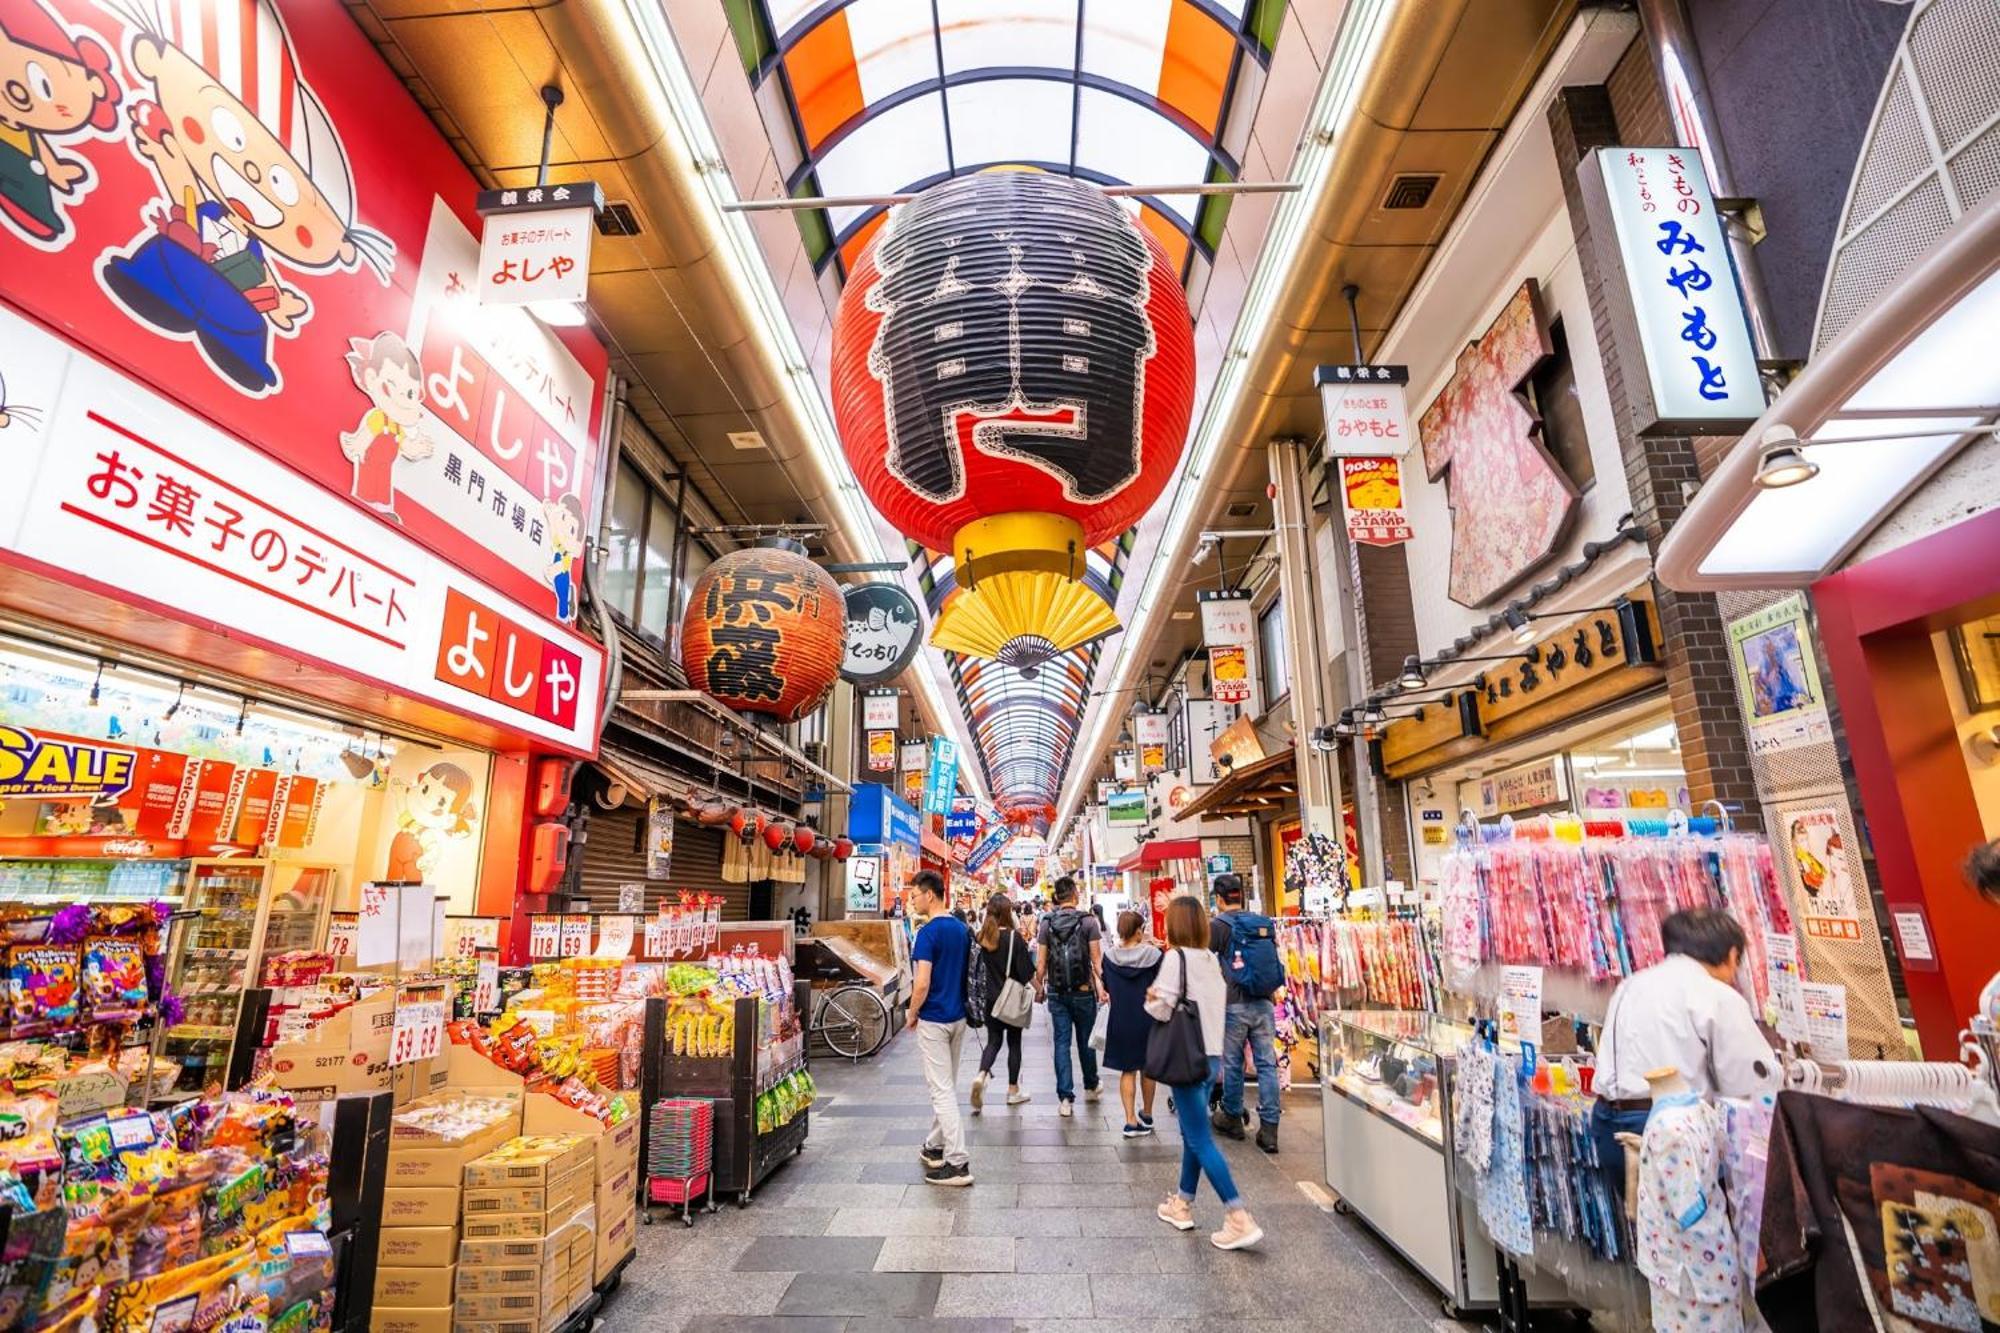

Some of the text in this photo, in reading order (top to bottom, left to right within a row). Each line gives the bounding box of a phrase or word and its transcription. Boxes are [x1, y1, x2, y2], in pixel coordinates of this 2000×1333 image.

[1667, 154, 1700, 215] きもの
[501, 228, 571, 246] お菓子のデパート
[492, 256, 574, 284] よしや
[1656, 220, 1728, 400] みやもと
[428, 345, 568, 494] よしや
[1338, 418, 1399, 438] みやもと
[443, 453, 544, 546] 黒門市場店
[1350, 517, 1406, 527] STAMP
[87, 449, 407, 628] お菓子のデパート
[447, 610, 577, 717] よしや
[1520, 619, 1618, 694] みやもと
[0, 726, 132, 785] SALE
[171, 760, 199, 836] Welcome
[219, 768, 247, 840] Welcome
[266, 776, 290, 844] Welcome
[305, 782, 327, 847] Welcome
[947, 819, 963, 827] Eat
[332, 936, 349, 955] 78
[458, 937, 475, 956] 95
[534, 937, 553, 954] 118
[564, 937, 580, 955] 59
[315, 1055, 345, 1068] 52177
[395, 1025, 437, 1062] 59 68
